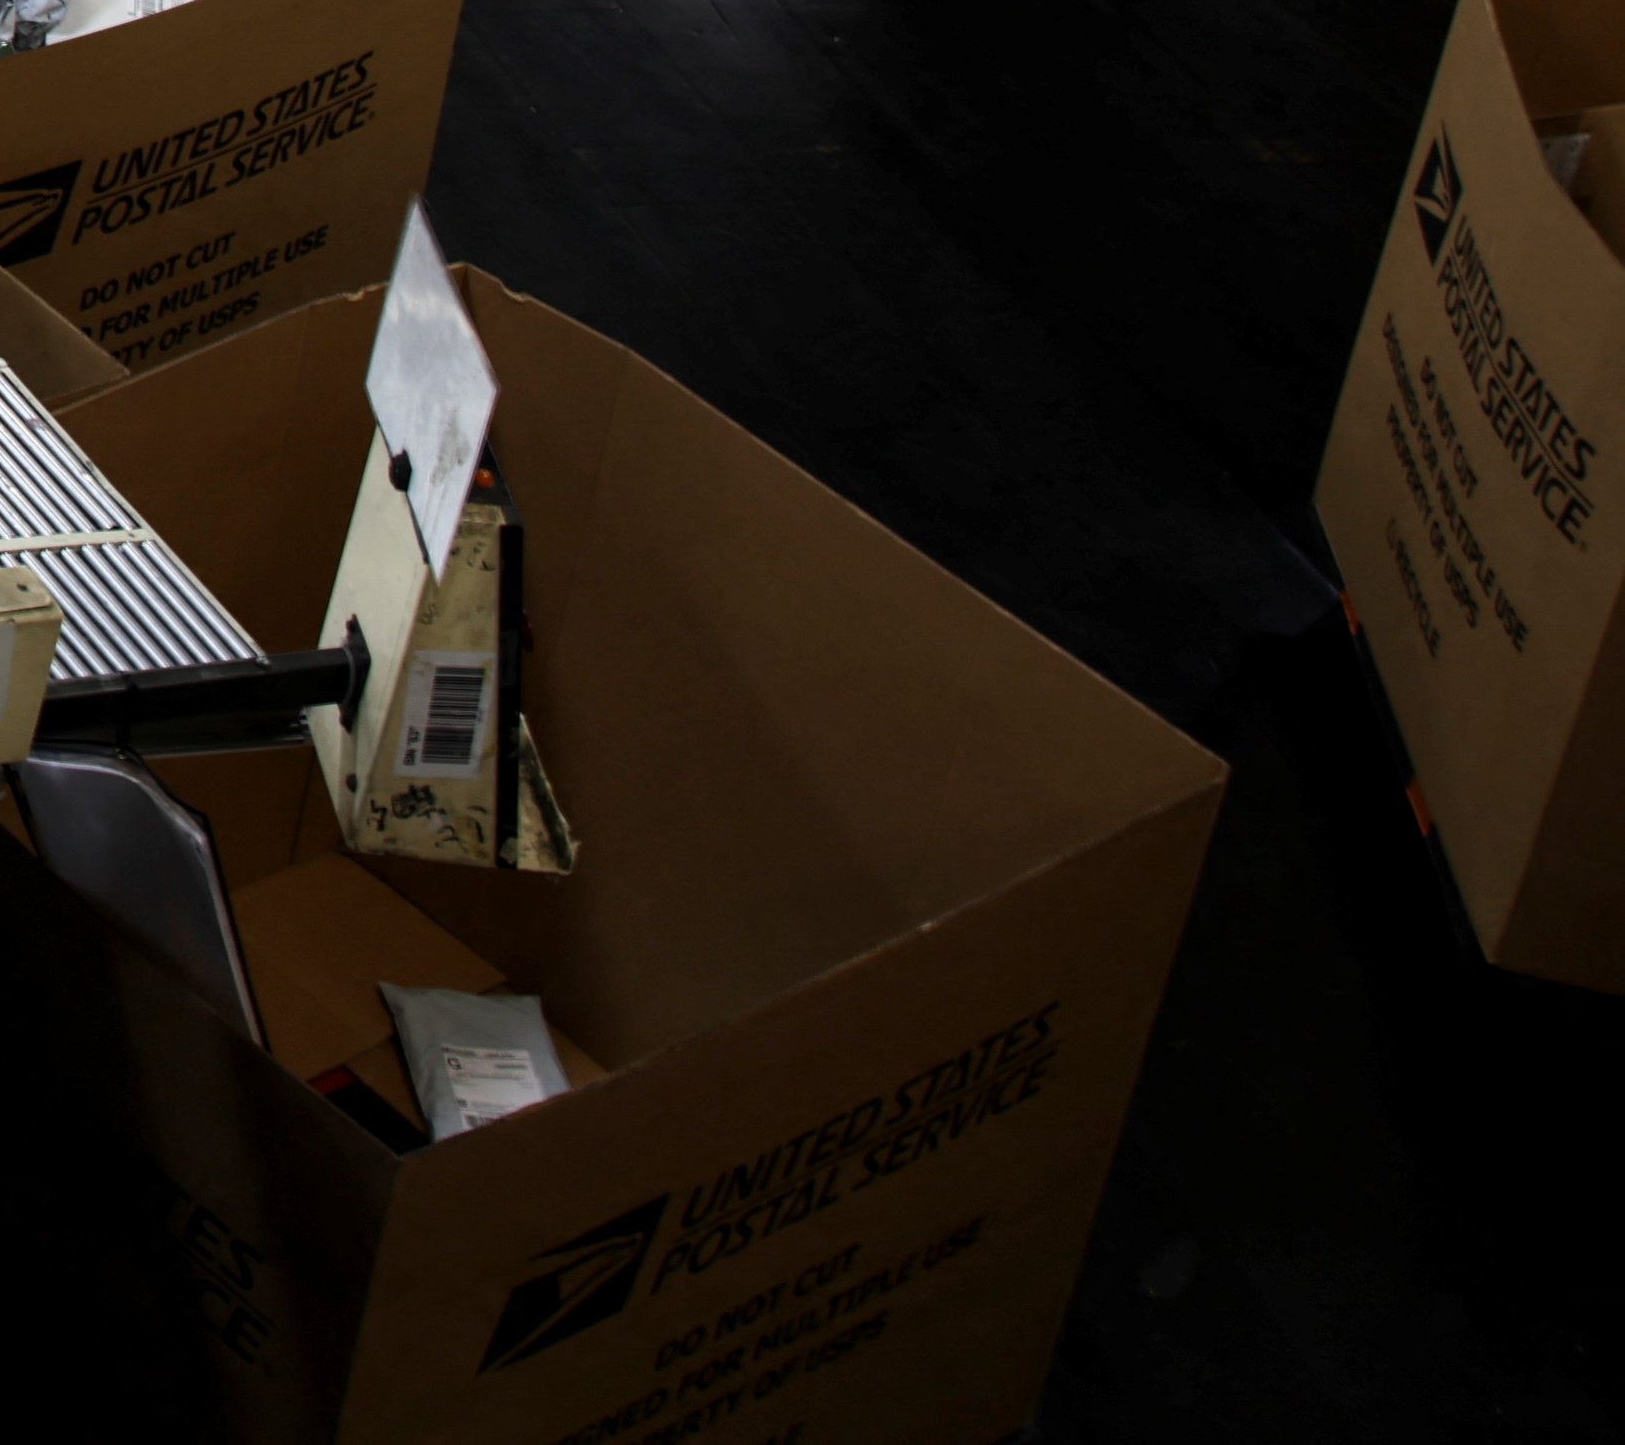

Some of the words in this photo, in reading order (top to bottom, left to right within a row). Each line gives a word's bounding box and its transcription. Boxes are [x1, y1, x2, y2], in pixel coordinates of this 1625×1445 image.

[71, 162, 217, 247] POSTAL
[224, 91, 374, 188] SERVICE
[92, 110, 246, 194] UNITED
[246, 51, 374, 137] STATES
[80, 279, 119, 312] DO
[126, 254, 181, 296] NOT
[185, 231, 236, 270] CUT
[99, 304, 151, 342] FOR
[158, 247, 280, 320] MULTIPLE
[283, 224, 330, 263] USE
[159, 321, 193, 352] OF
[198, 291, 261, 335] USPS
[1436, 256, 1487, 394] POSTAL
[1480, 376, 1591, 546] SERVICE
[1452, 213, 1505, 351] UNITED
[1498, 335, 1597, 483] STATES
[650, 1166, 840, 1297] POSTAL
[852, 1051, 1057, 1193] SERVICE
[680, 1097, 882, 1230] UNITED
[885, 999, 1060, 1128] STATES
[654, 1325, 707, 1372] DO
[714, 1281, 790, 1341] NOT
[794, 1242, 864, 1298] CUT
